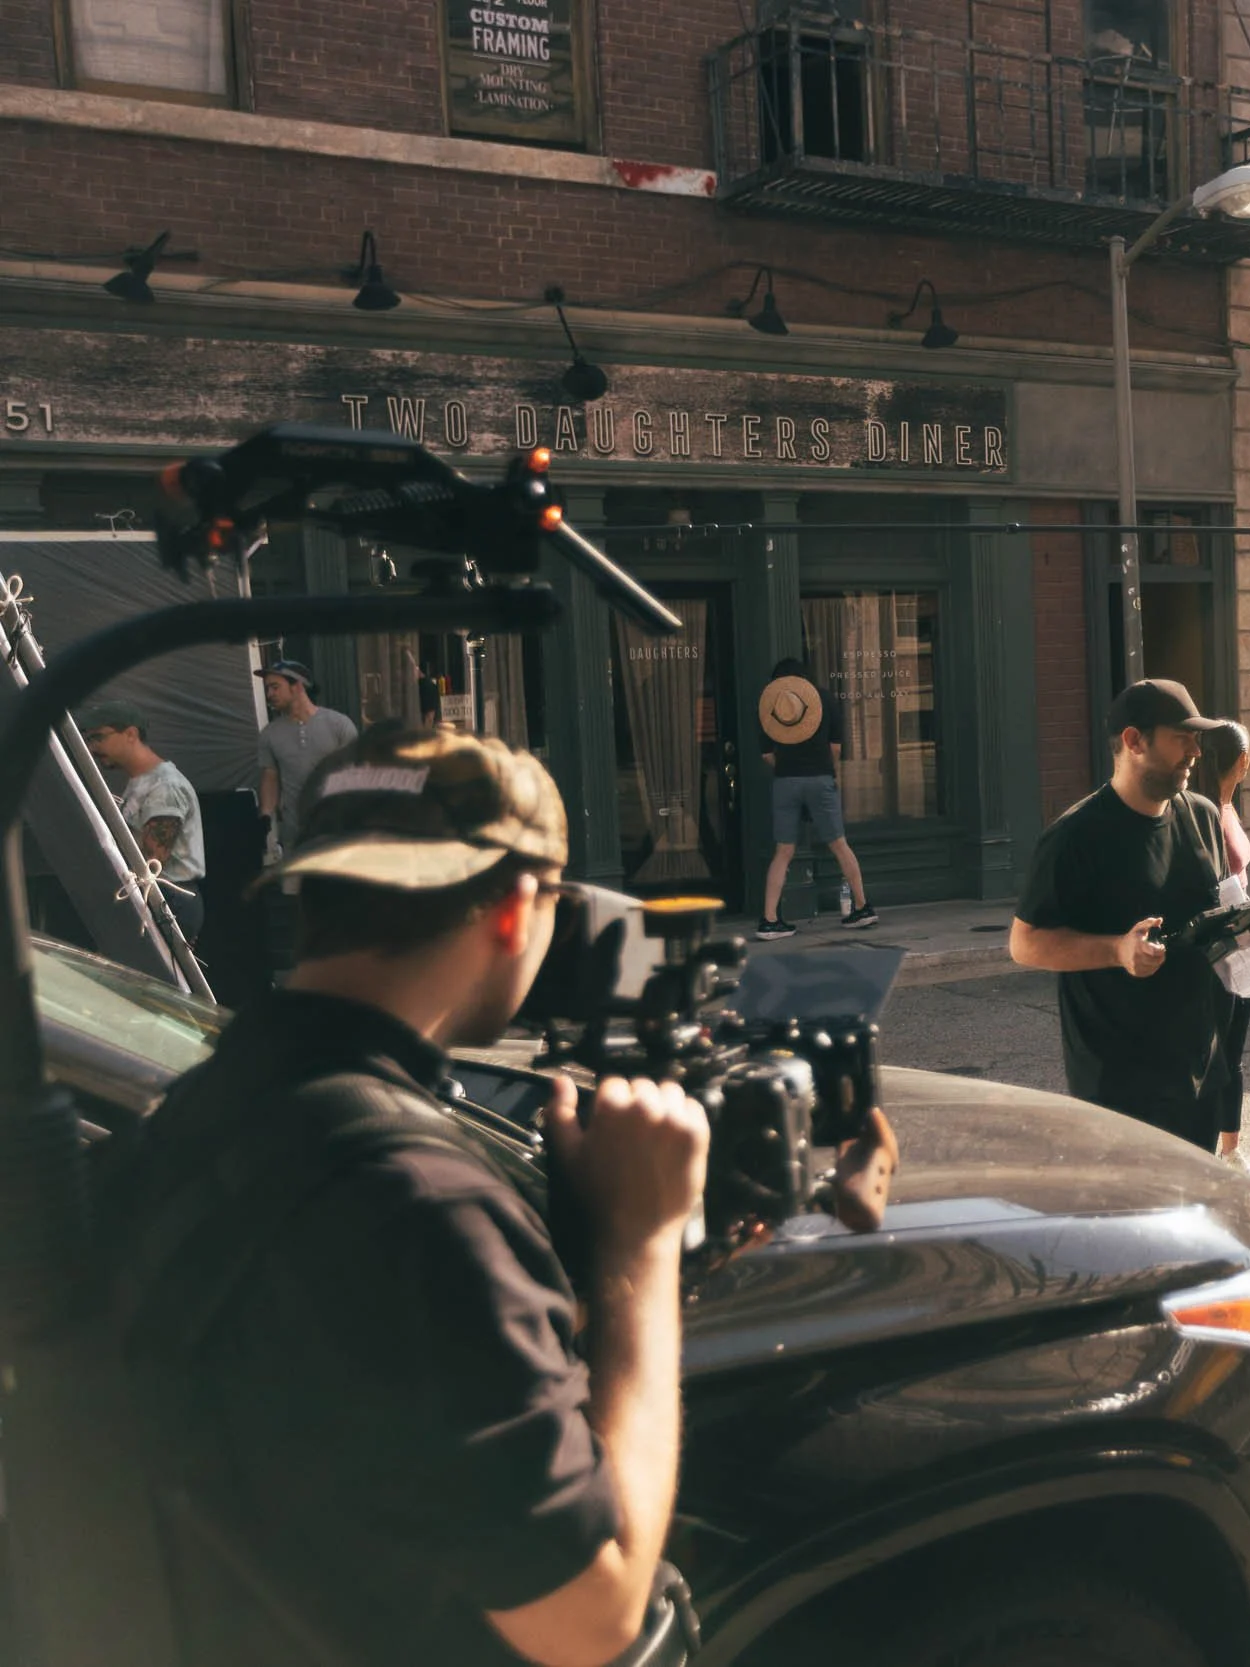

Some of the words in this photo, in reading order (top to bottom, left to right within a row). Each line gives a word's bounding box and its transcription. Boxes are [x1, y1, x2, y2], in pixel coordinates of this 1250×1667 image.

[470, 8, 549, 34] CUSTOM
[472, 26, 550, 61] FRAMING
[500, 63, 526, 77] DRY
[480, 73, 547, 94] MOUNTING
[479, 90, 550, 111] LAMINATION
[5, 401, 54, 432] 51
[342, 394, 468, 447] TWO
[515, 403, 831, 461] DAUGHTERS
[867, 420, 1004, 467] DINER
[629, 646, 699, 660] DAUGHTERS
[843, 649, 897, 659] ESPRESSO
[829, 670, 877, 679] PRESSED
[881, 669, 911, 679] JUICE
